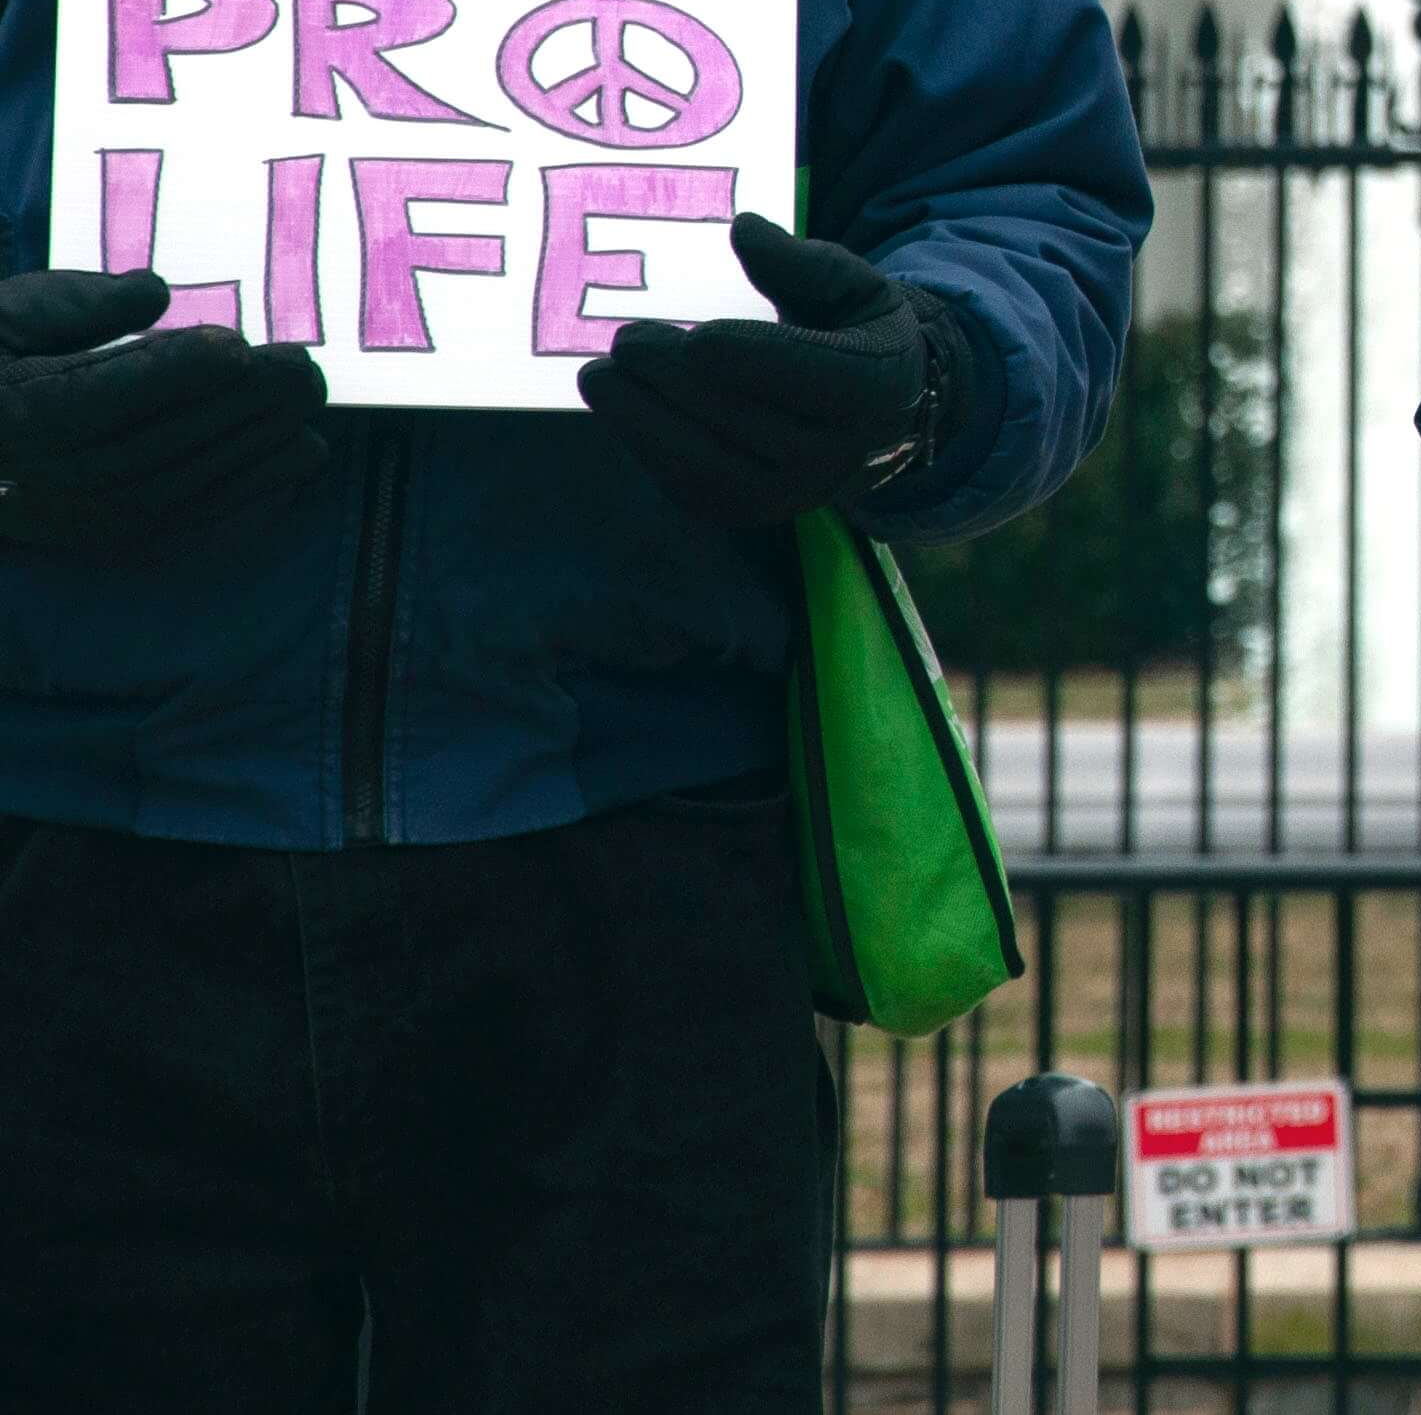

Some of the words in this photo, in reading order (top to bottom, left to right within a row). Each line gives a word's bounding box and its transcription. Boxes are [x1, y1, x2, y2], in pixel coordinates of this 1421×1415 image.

[94, 144, 737, 356] LIFE
[1157, 1164, 1218, 1195] DO
[1232, 1157, 1319, 1189] NOT
[1169, 1196, 1314, 1229] ENTER
